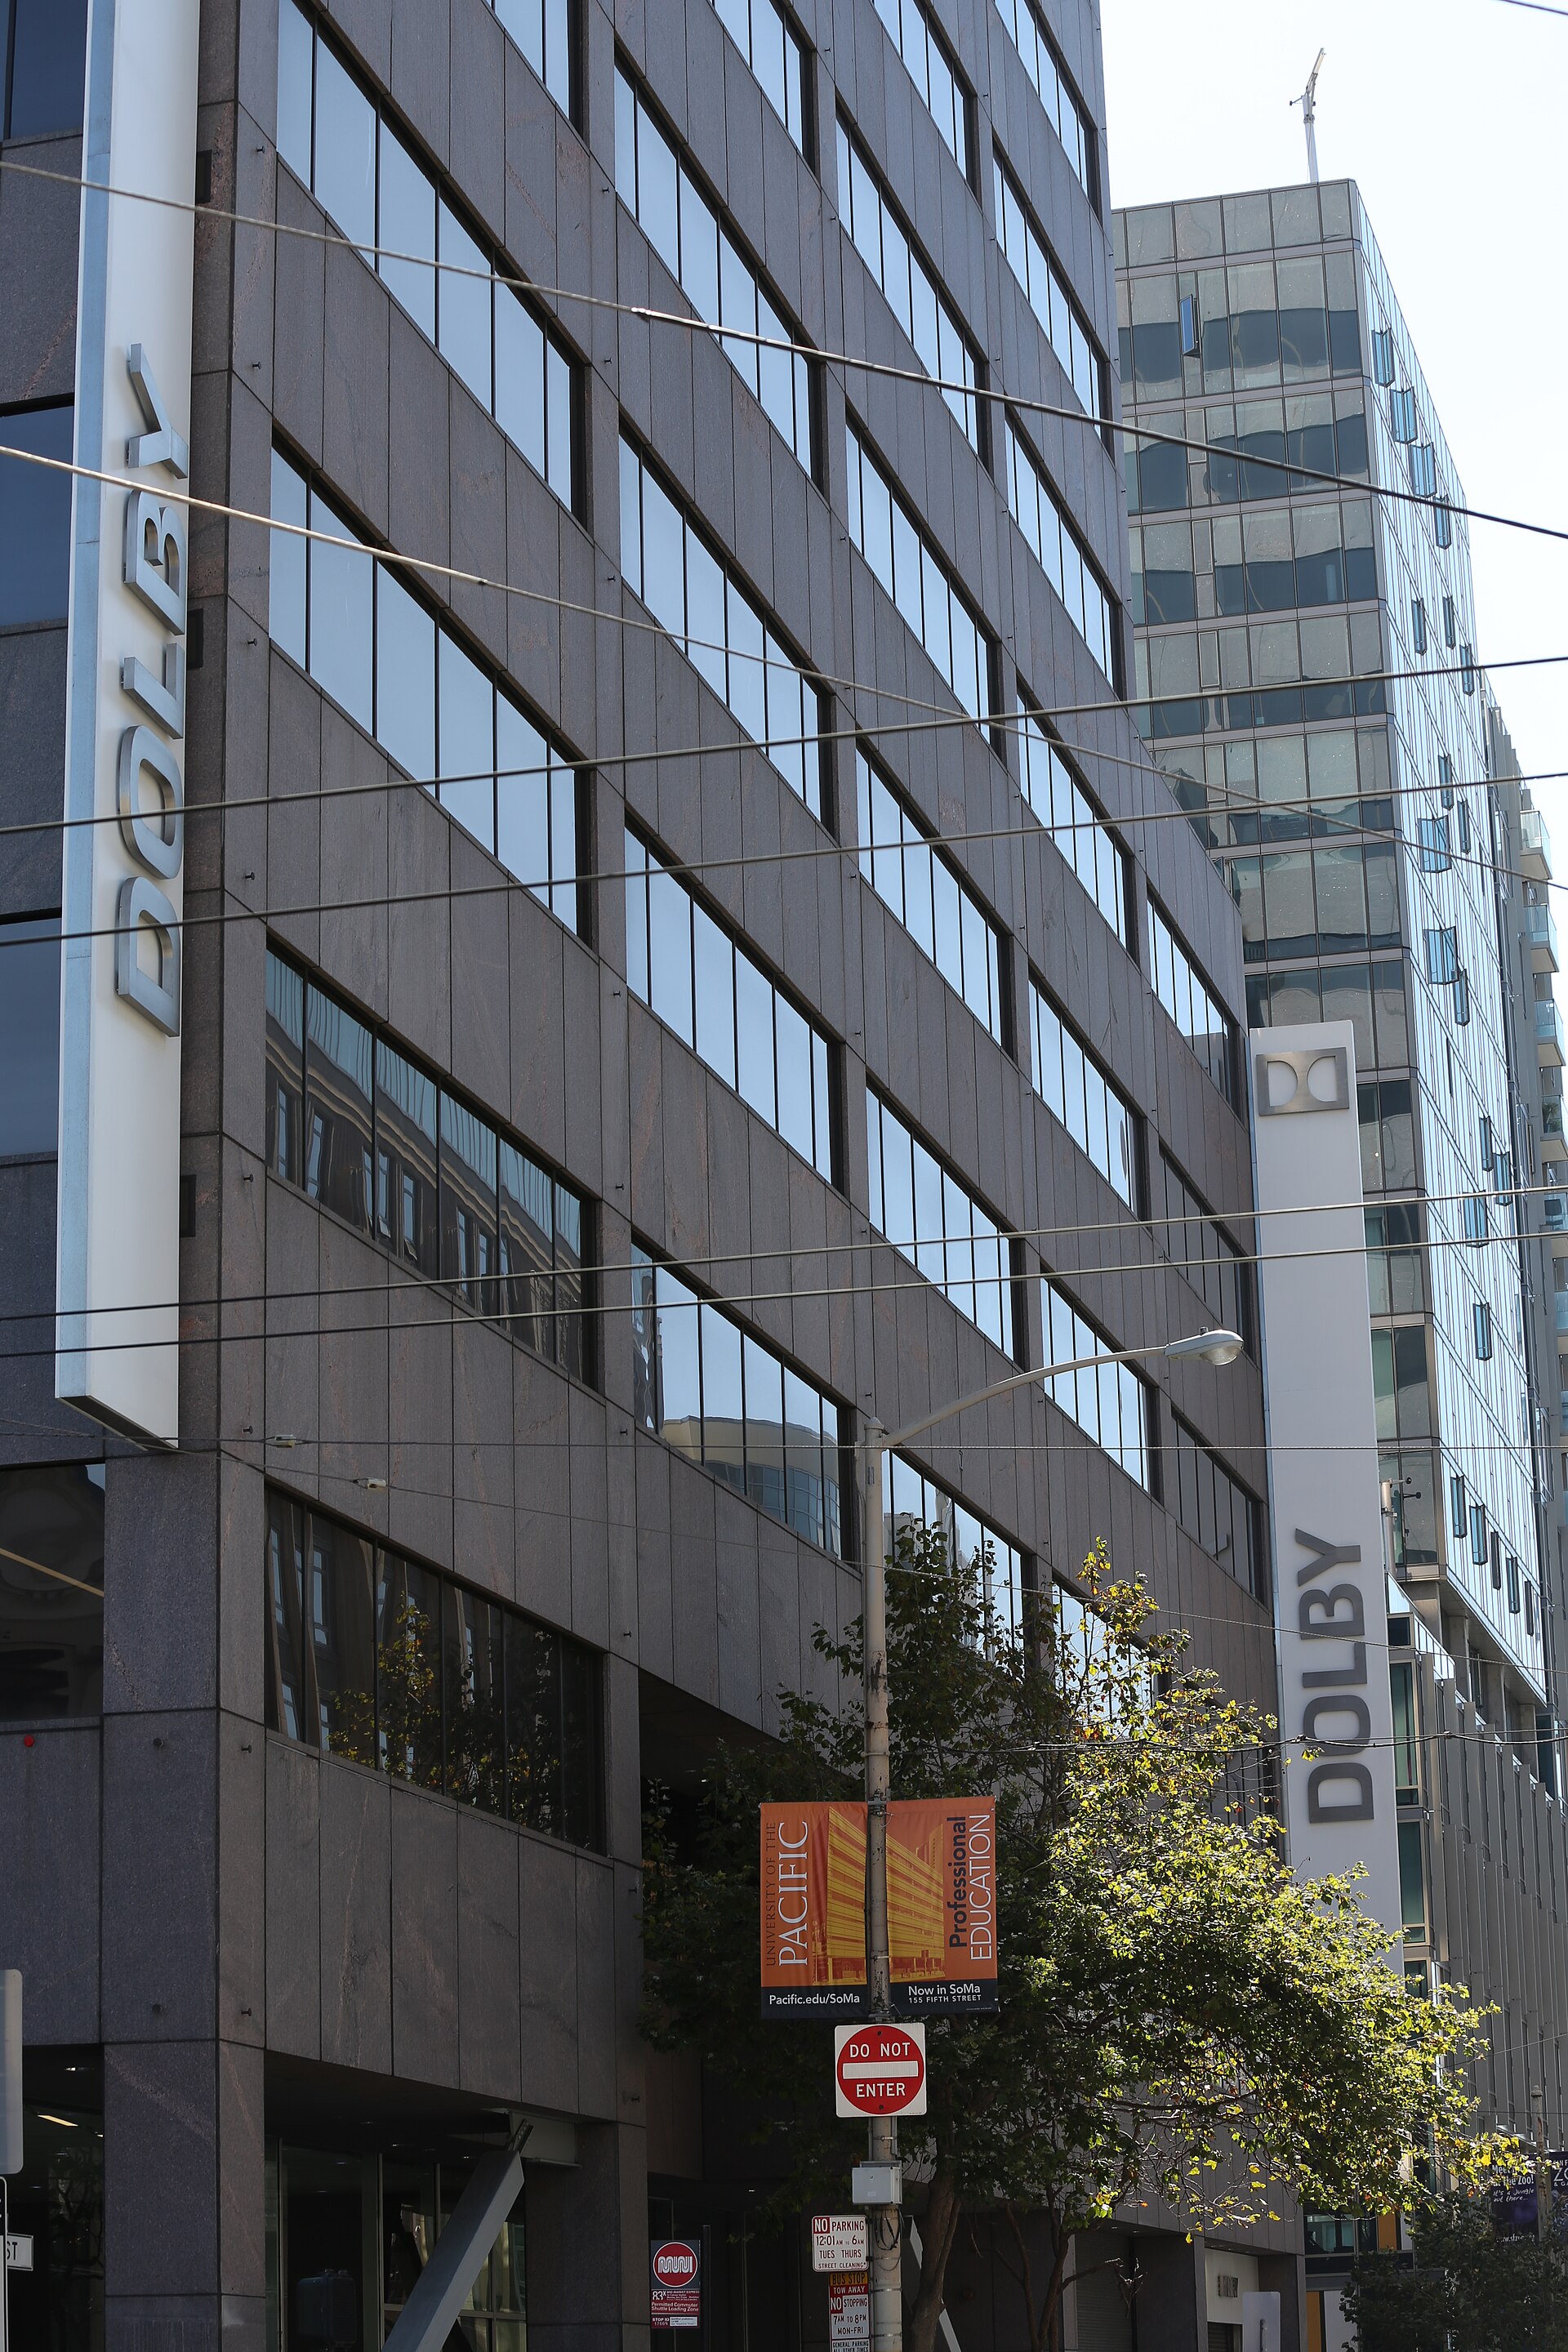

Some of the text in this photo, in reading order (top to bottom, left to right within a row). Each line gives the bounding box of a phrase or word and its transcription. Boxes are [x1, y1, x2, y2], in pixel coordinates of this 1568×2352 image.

[117, 343, 189, 1038] DOLBY
[1295, 1528, 1374, 1823] DOLBY
[947, 1816, 967, 1948] Professional
[968, 1815, 992, 1960] EDUCATION
[766, 1823, 776, 1967] UNIVERSITY OF THE
[777, 1821, 808, 1967] PACIFIC
[908, 1983, 981, 1996] Now in SoMa
[769, 1993, 860, 2006] Pacific.edu/SoMa
[952, 1994, 981, 2002] STREET
[849, 2042, 911, 2058] DO NOT
[856, 2082, 906, 2098] ENTER
[1517, 2174, 1535, 2185] Zoo!
[814, 2218, 864, 2232] NO PARKING
[819, 2249, 862, 2259] TUES THURS
[833, 2272, 865, 2284] BUS STOP
[831, 2296, 867, 2310] NO STOPPING
[837, 2327, 863, 2335] MON-FRI
